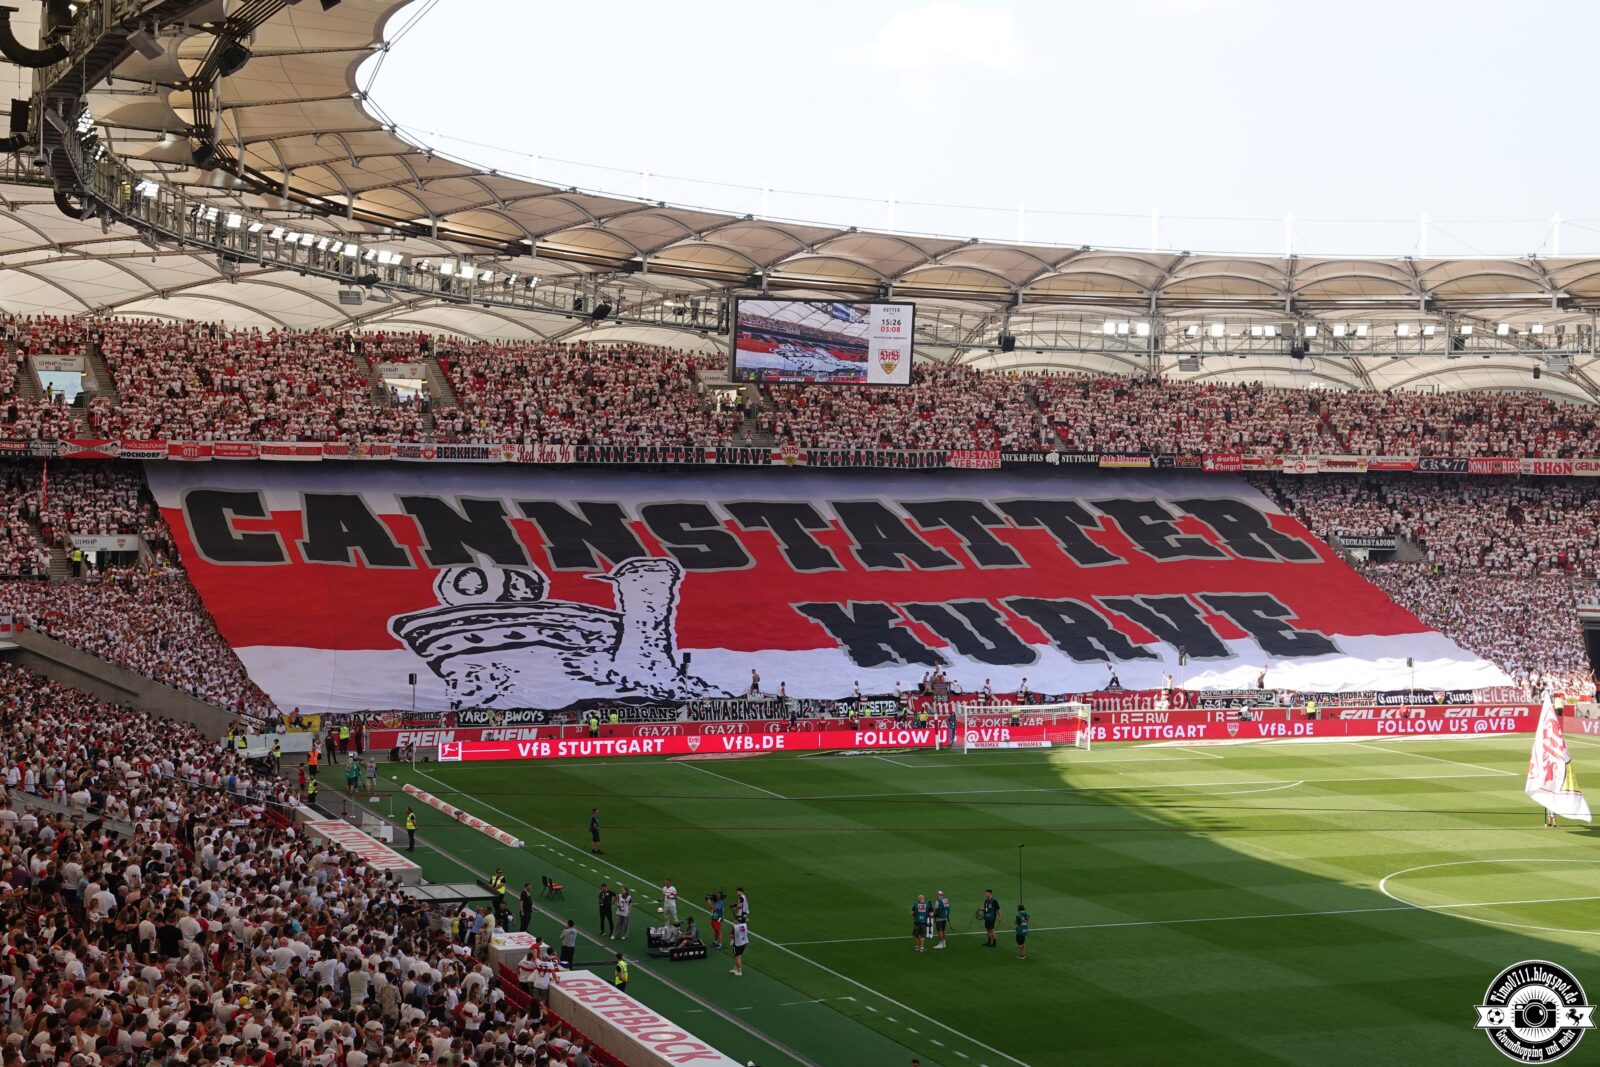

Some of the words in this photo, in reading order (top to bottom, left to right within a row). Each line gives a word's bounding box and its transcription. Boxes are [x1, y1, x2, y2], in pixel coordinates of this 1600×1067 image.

[436, 446, 489, 459] BERKHEIM
[517, 444, 534, 463] Red
[537, 444, 557, 463] Hots
[559, 444, 570, 463] 96
[575, 446, 706, 463] CANNSTATTER
[716, 447, 772, 465] KURVE
[807, 450, 948, 468] NECKARSTADION
[952, 450, 1001, 459] ALBSTADT
[1001, 453, 1043, 462] NECKAR-FILS
[1061, 454, 1100, 463] STUTTGART
[953, 459, 1000, 468] VFB-FANS
[1453, 459, 1467, 471] 77
[1468, 460, 1493, 473] DONAU
[1502, 460, 1520, 473] RIES
[183, 487, 1325, 571] CANNSTATTER
[1341, 538, 1395, 547] NECKARSTADION
[790, 591, 1345, 668] KURVE
[1377, 691, 1434, 705] Cannstatter
[1446, 691, 1473, 704] Jungs
[458, 710, 489, 723] YARD
[504, 710, 545, 723] BWOYS
[599, 707, 677, 720] HOLIGANS
[1444, 706, 1529, 719] FALKEN
[980, 717, 1044, 727] JOKESTAR
[1258, 722, 1314, 736] VfB.DE
[1377, 719, 1443, 733] FOLLOW
[1449, 719, 1468, 732] US
[1474, 718, 1516, 733] @VfB
[638, 725, 678, 737] GAZI
[704, 724, 744, 735] GAZI
[855, 730, 930, 746] FOLLOW
[966, 727, 1011, 743] @VfB
[1081, 726, 1107, 741] VfB
[1112, 724, 1207, 739] STUTTGART
[395, 731, 455, 747] EHEIM
[722, 734, 785, 751] VfB.DE
[517, 742, 551, 757] VfB
[558, 738, 665, 756] STUTTGART
[326, 831, 416, 869] STUTTGART
[557, 978, 722, 1064] GÄSTEBLOCK
